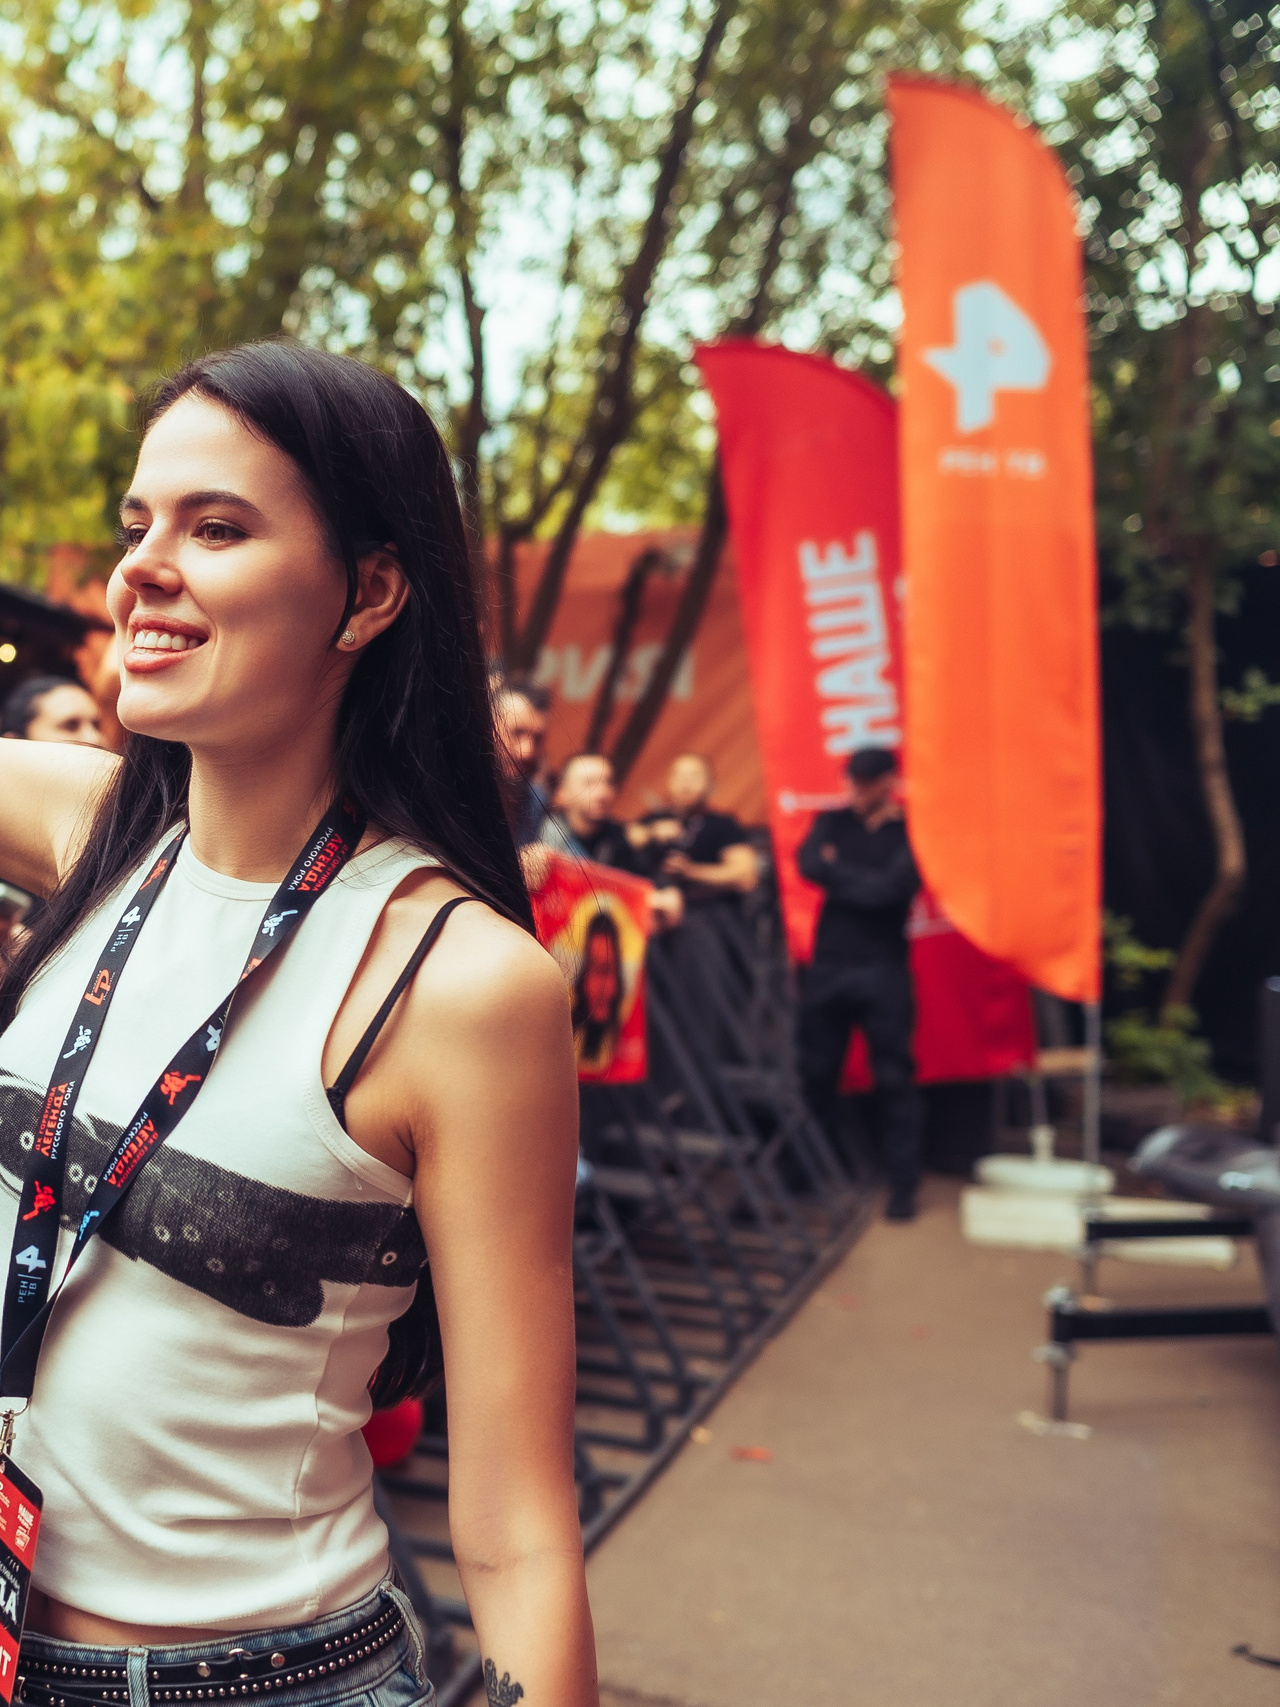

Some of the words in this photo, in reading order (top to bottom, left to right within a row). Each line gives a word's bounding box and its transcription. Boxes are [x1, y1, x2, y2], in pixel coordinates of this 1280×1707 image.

[797, 530, 903, 756] НАШЕ
[297, 833, 343, 891] ЛЕГЕНДА
[303, 826, 334, 867] РУССКОГО
[287, 869, 307, 891] РОКА
[110, 934, 124, 952] РЕН
[35, 1137, 42, 1151] ДК
[39, 1086, 57, 1134] ГОРБУНОВА
[40, 1082, 68, 1157] ЛЕГЕНДА
[50, 1110, 66, 1160] РУССКОГО
[63, 1081, 75, 1106] РОКА
[117, 1111, 149, 1156] РУССКОГО
[103, 1157, 119, 1181] РОКА
[108, 1119, 155, 1185] ЛЕГЕНДА
[17, 1280, 29, 1303] РЕН
[27, 1282, 38, 1297] ТВ
